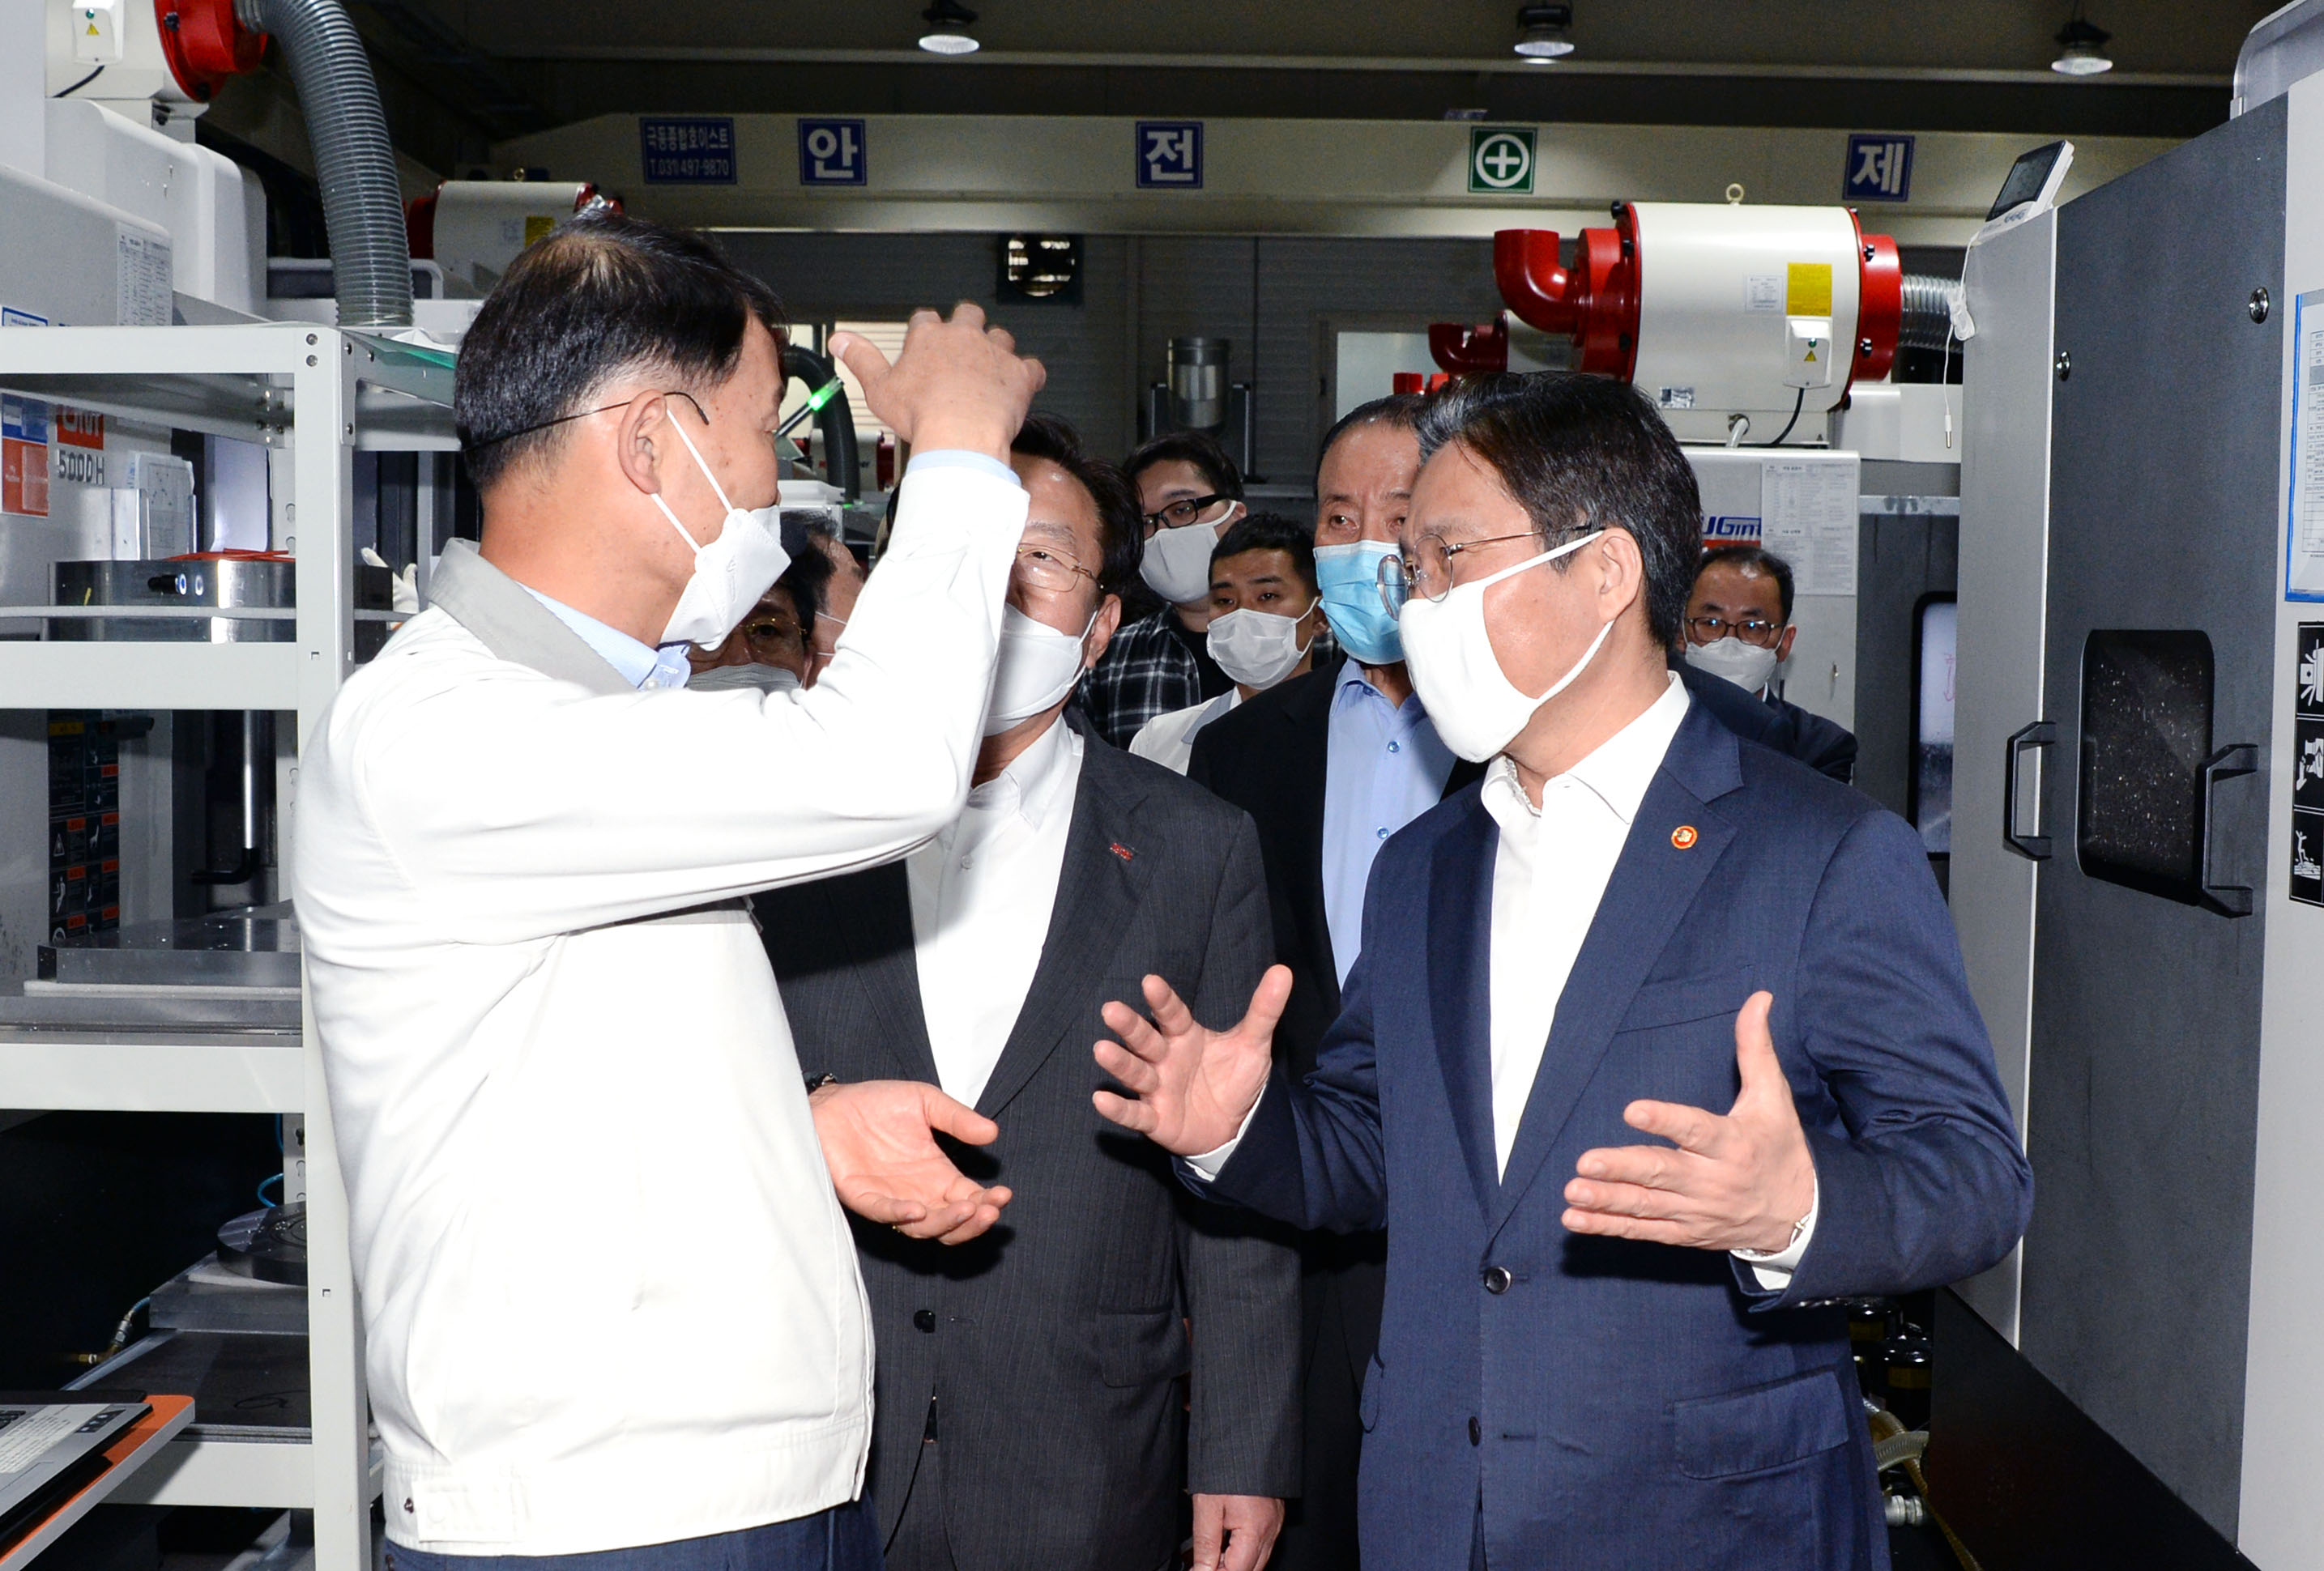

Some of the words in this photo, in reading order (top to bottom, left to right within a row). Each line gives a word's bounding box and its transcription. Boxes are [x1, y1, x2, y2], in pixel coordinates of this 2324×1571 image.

[808, 126, 859, 179] 안
[1145, 130, 1194, 181] 전
[1852, 143, 1905, 194] 제
